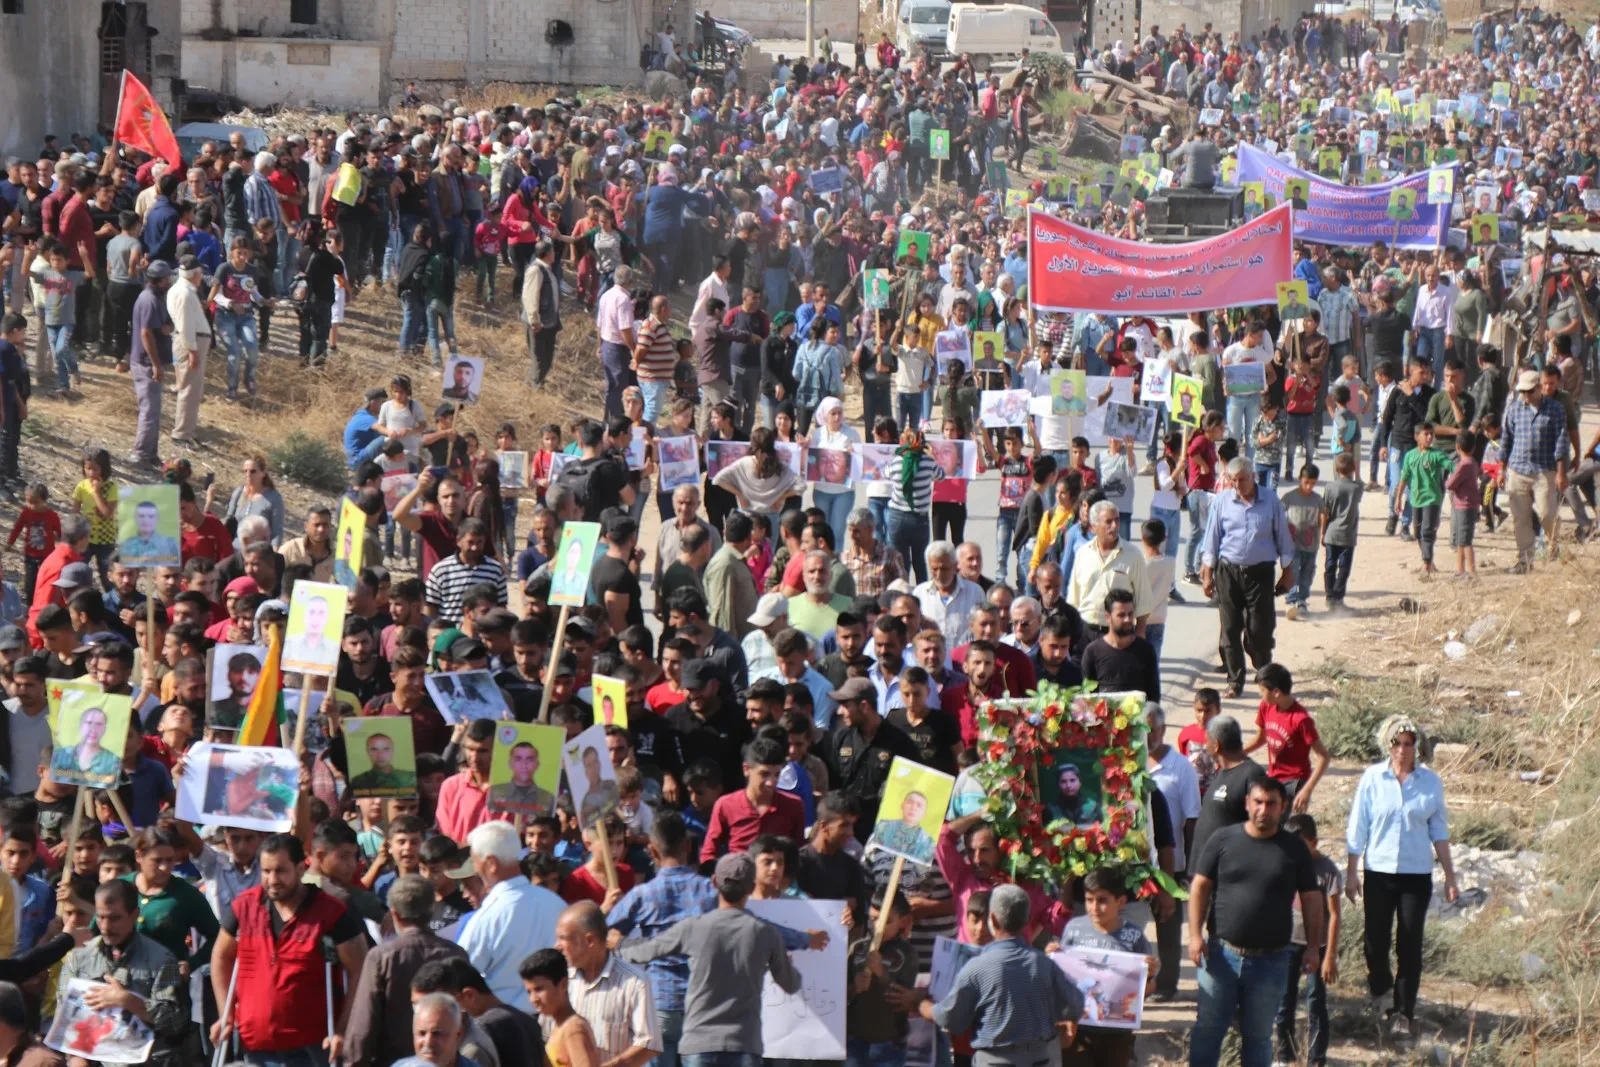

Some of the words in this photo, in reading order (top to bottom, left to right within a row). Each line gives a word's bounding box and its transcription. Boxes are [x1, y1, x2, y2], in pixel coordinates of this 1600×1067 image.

[1035, 224, 1068, 243] سوريا
[1046, 252, 1079, 273] الأول
[1080, 258, 1123, 276] تشرين
[1197, 255, 1244, 277] استمرار
[1245, 251, 1265, 269] هو
[1135, 284, 1177, 300] القائد
[1179, 283, 1204, 298] ضد
